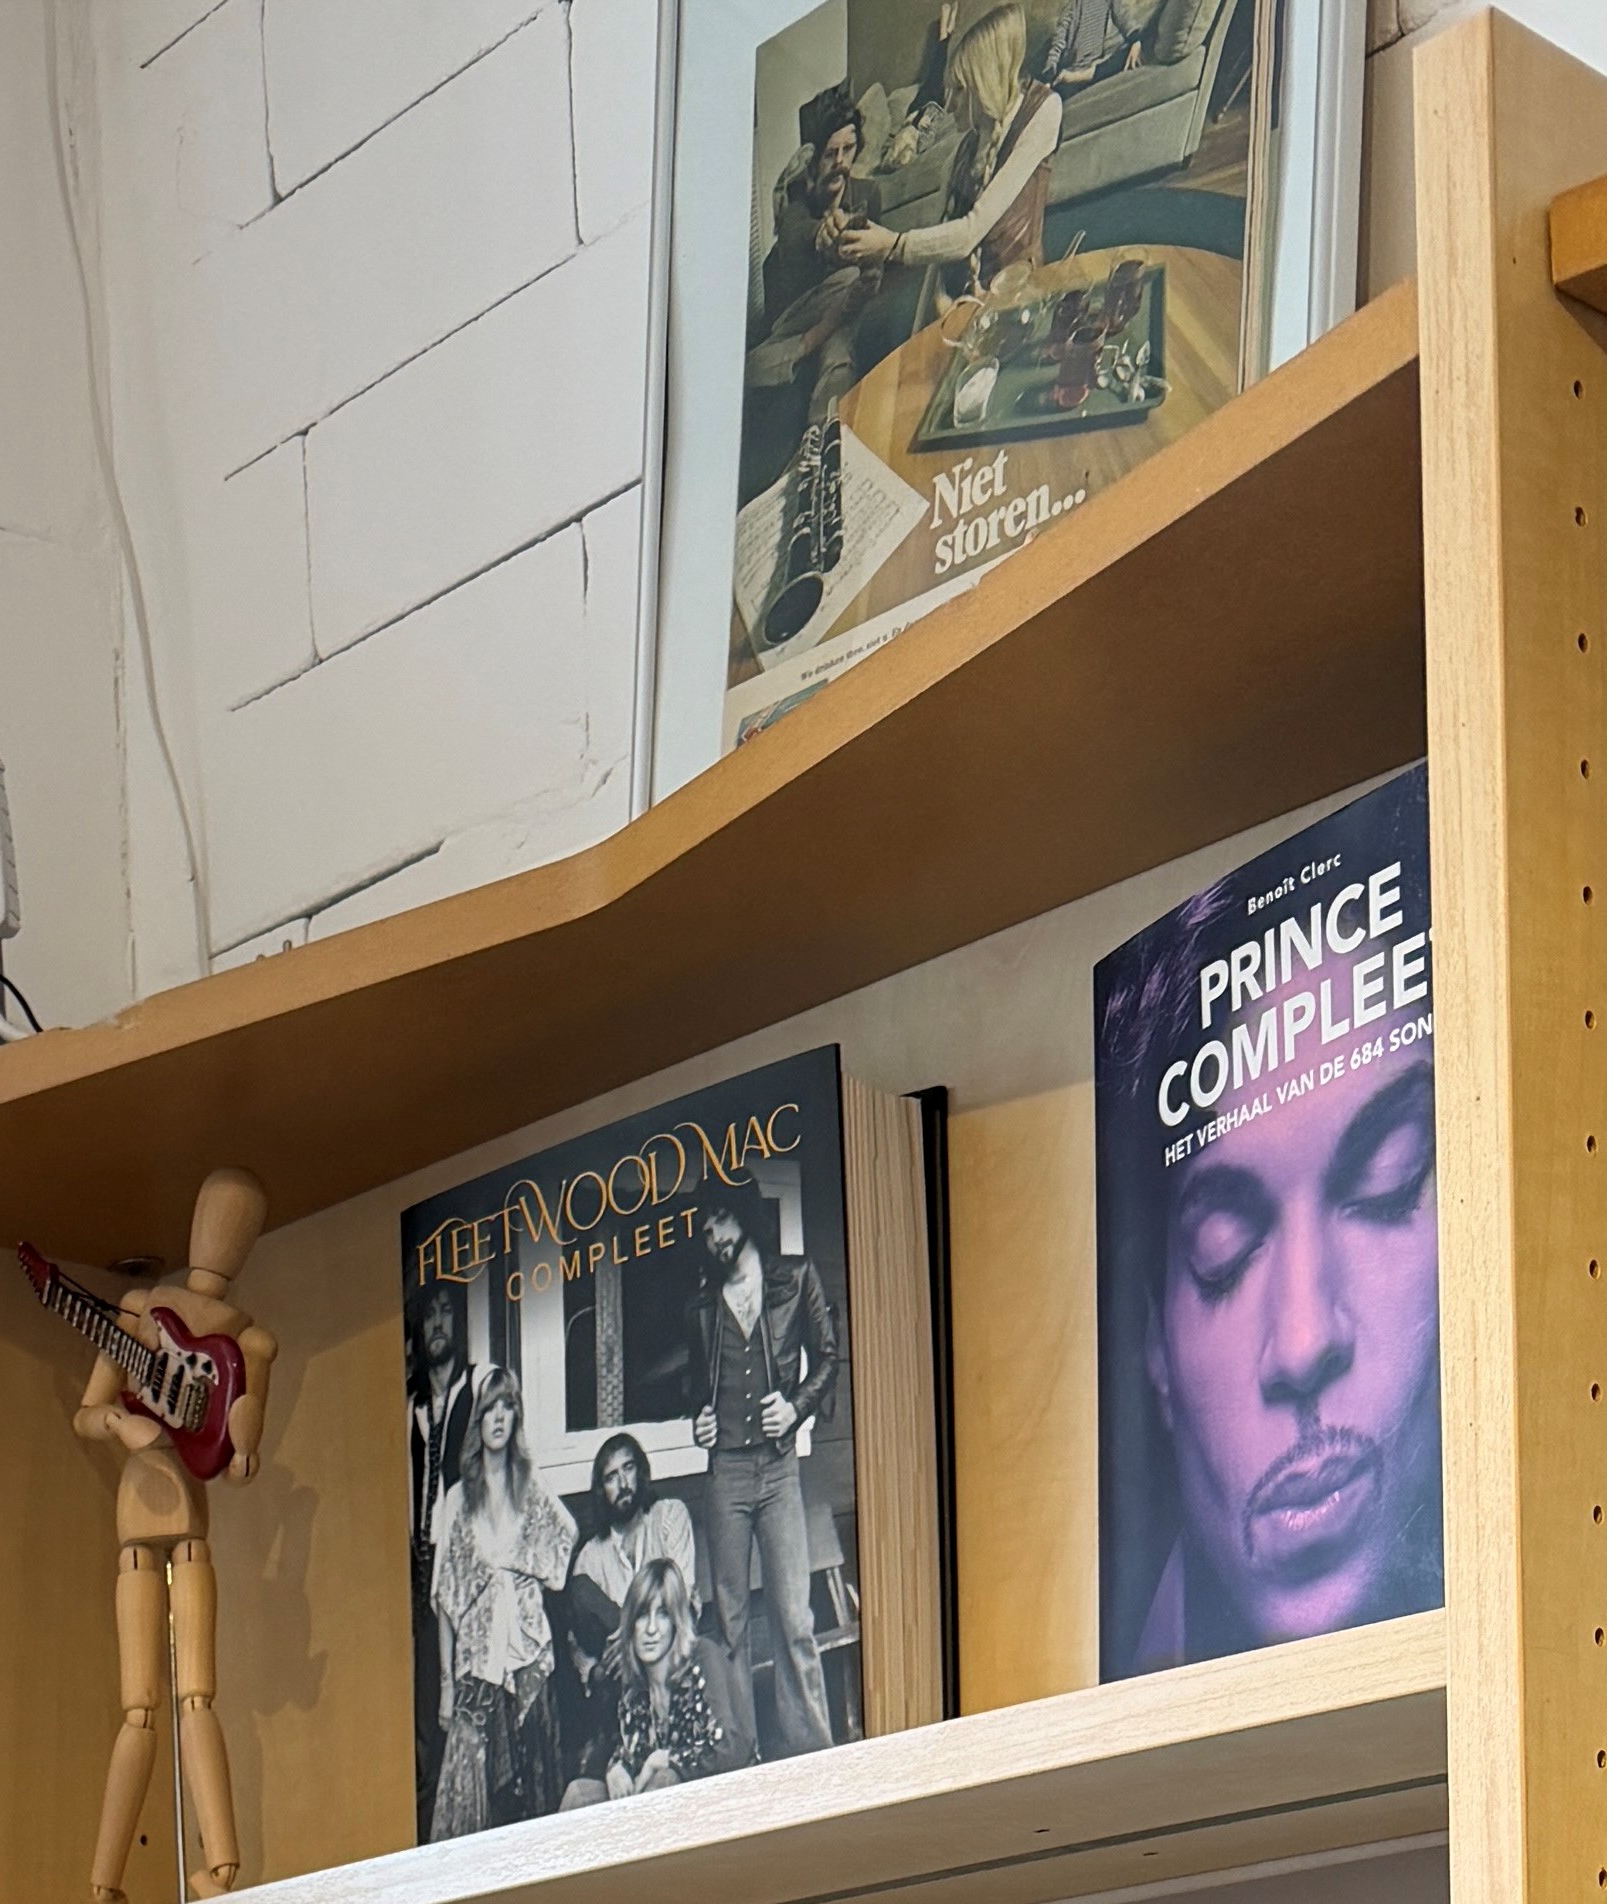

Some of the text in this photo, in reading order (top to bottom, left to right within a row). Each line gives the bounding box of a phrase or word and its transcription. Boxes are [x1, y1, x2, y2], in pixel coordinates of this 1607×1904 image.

[930, 449, 1008, 530] Niet
[934, 484, 1086, 575] storen...
[1200, 861, 1403, 1030] PRINCE
[1247, 853, 1343, 916] Benoît Clerc
[1158, 928, 1432, 1127] COMPLEE
[1164, 1013, 1433, 1167] HET VERHAAL VAN DE 684 SON
[416, 1103, 801, 1288] FLEETWOOD MAC
[506, 1207, 698, 1301] COMPLEET
